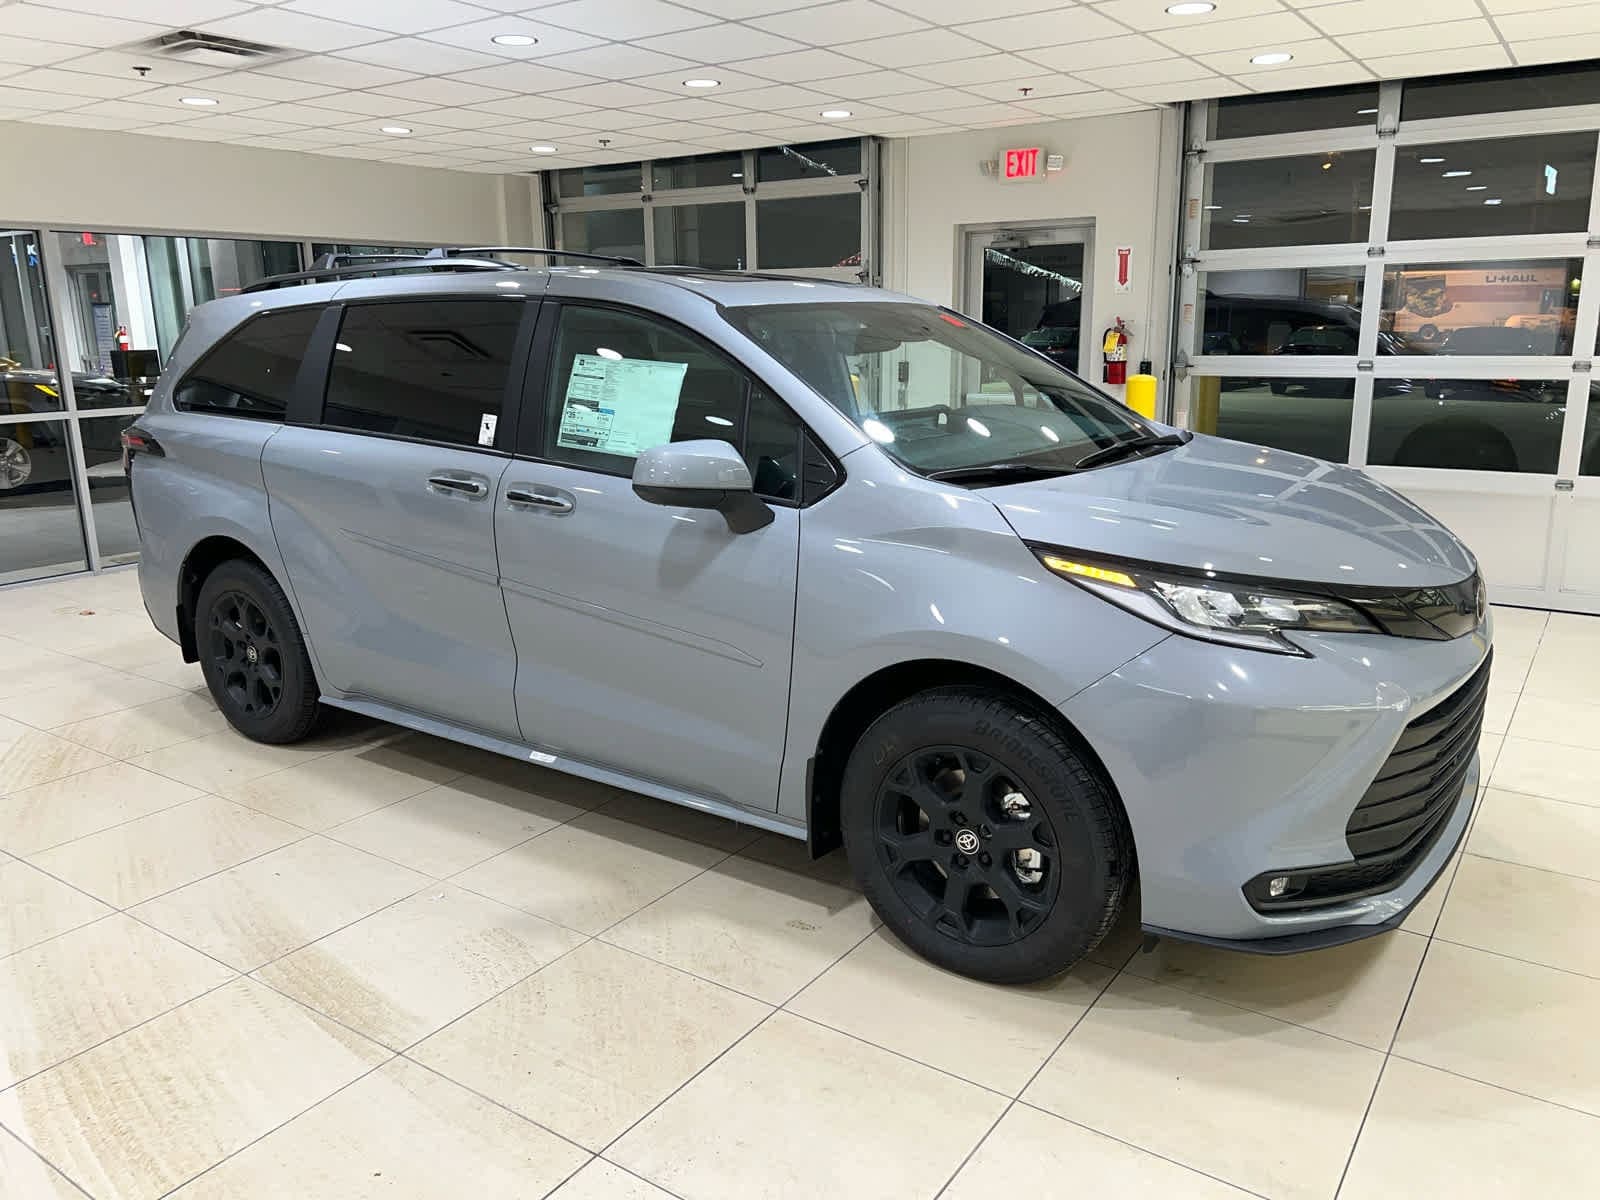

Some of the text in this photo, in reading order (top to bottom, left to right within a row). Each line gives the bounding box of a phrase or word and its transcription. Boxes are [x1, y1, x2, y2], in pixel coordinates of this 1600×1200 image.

[1006, 149, 1039, 178] EXIT
[1485, 273, 1538, 283] U-HAUL
[975, 719, 1078, 822] BRIDGESTONE
